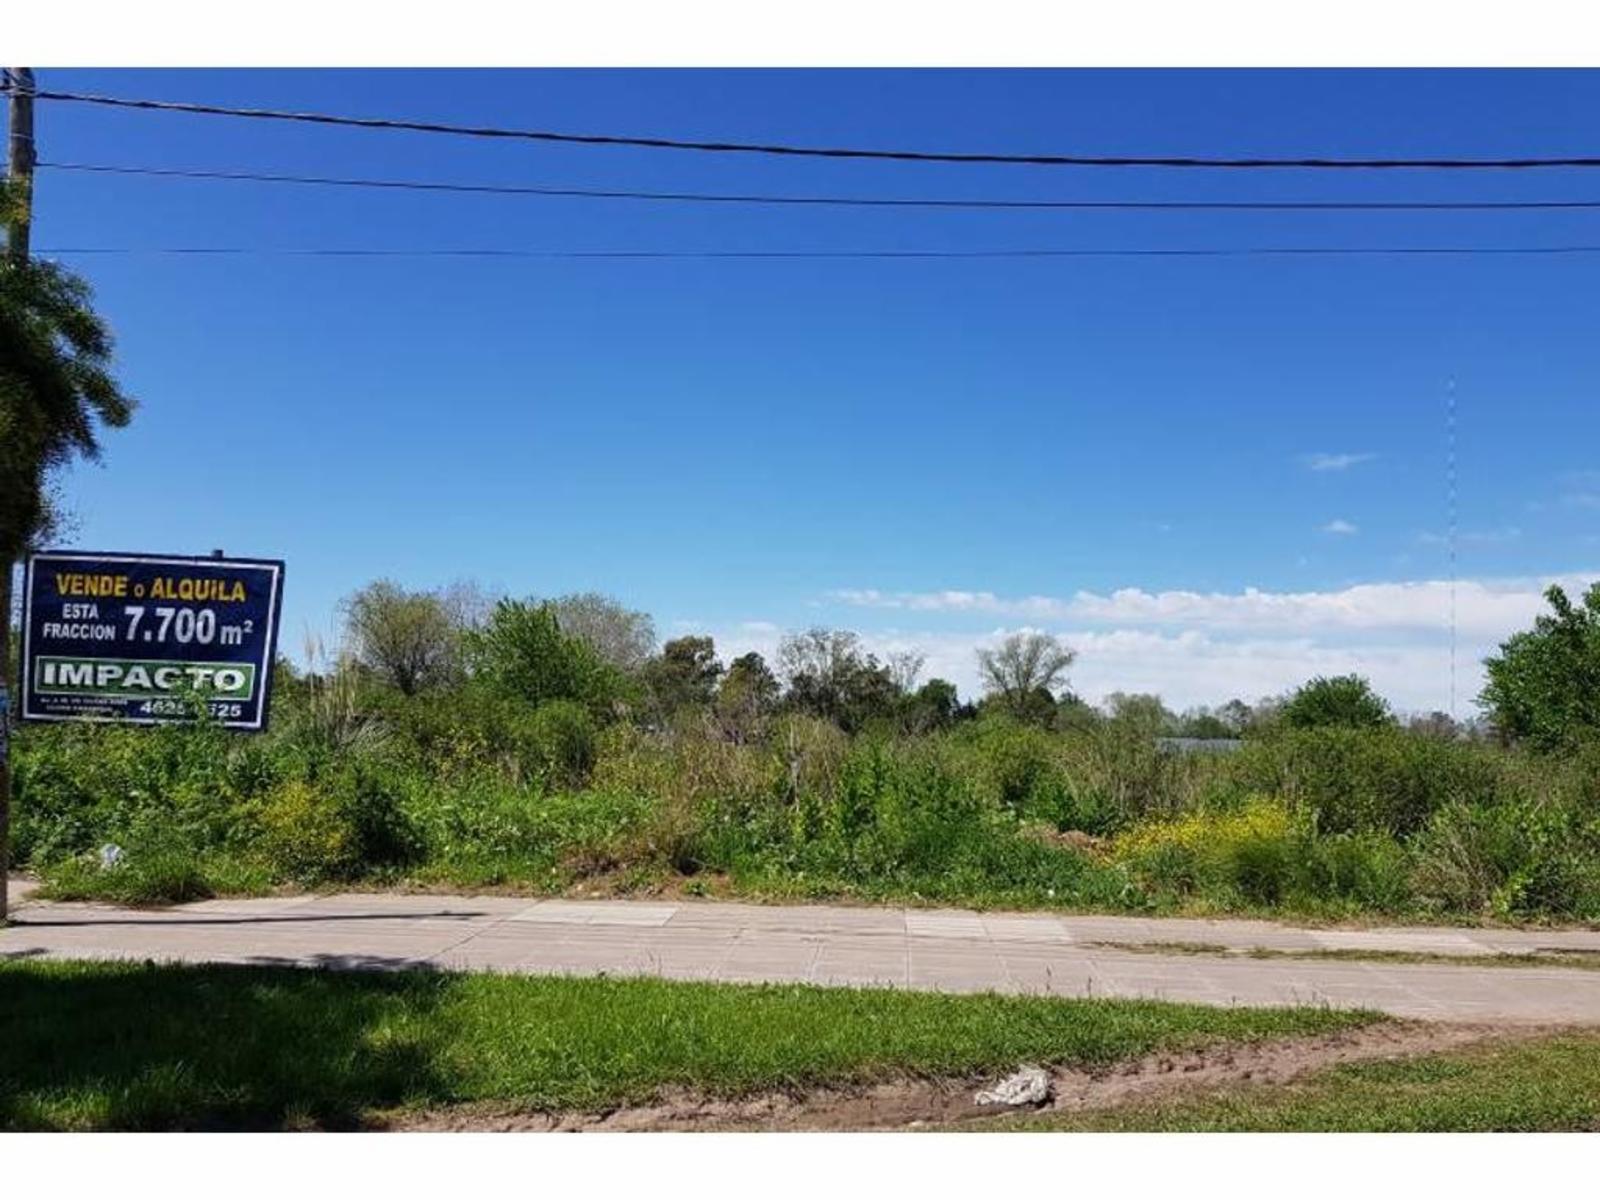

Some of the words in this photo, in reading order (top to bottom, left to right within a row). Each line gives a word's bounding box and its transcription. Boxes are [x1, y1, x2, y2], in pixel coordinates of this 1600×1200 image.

[56, 573, 128, 597] VENDE
[150, 577, 246, 602] ALQUILA
[62, 603, 98, 619] ESTA
[124, 605, 216, 644] 7.700
[43, 622, 115, 640] FRACCION
[43, 663, 246, 692] IMPACTO
